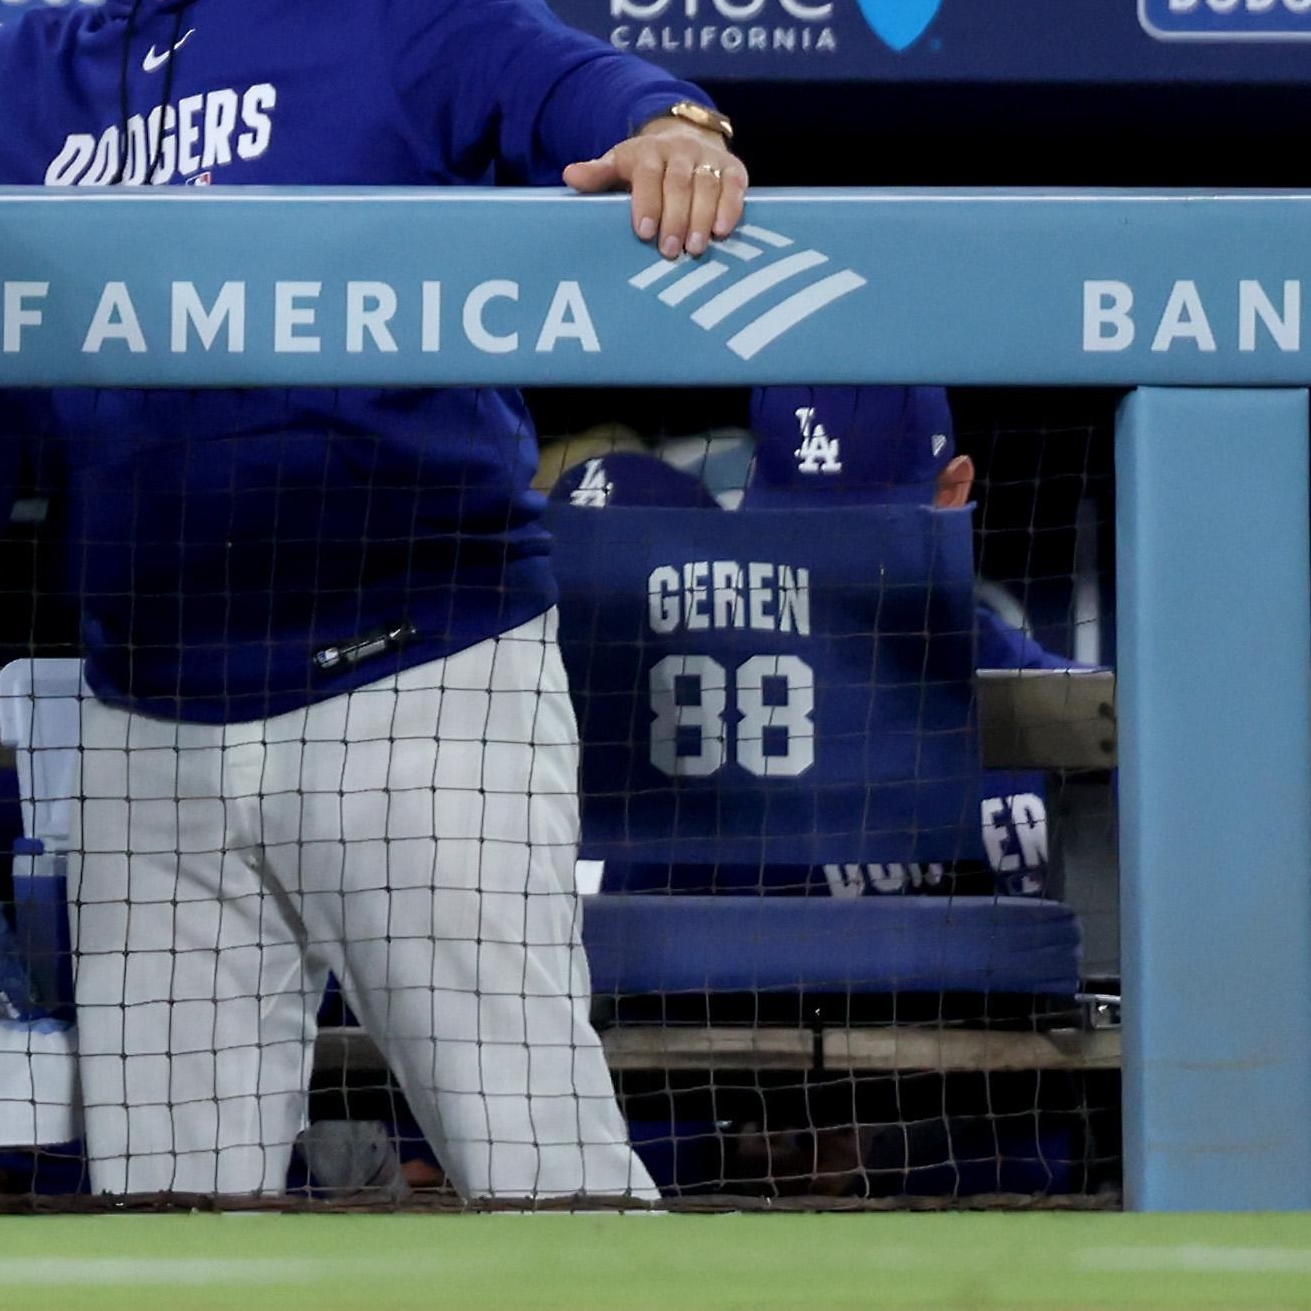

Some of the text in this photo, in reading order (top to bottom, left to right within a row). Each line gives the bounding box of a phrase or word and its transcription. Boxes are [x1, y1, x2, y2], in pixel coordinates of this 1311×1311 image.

[610, 25, 836, 53] CALIFORNIA
[45, 83, 277, 187] DODGERS
[81, 279, 602, 353] AMERICA
[1083, 279, 1300, 352] BAN
[795, 407, 843, 474] LA
[648, 560, 811, 636] GEREN
[649, 655, 815, 777] 88
